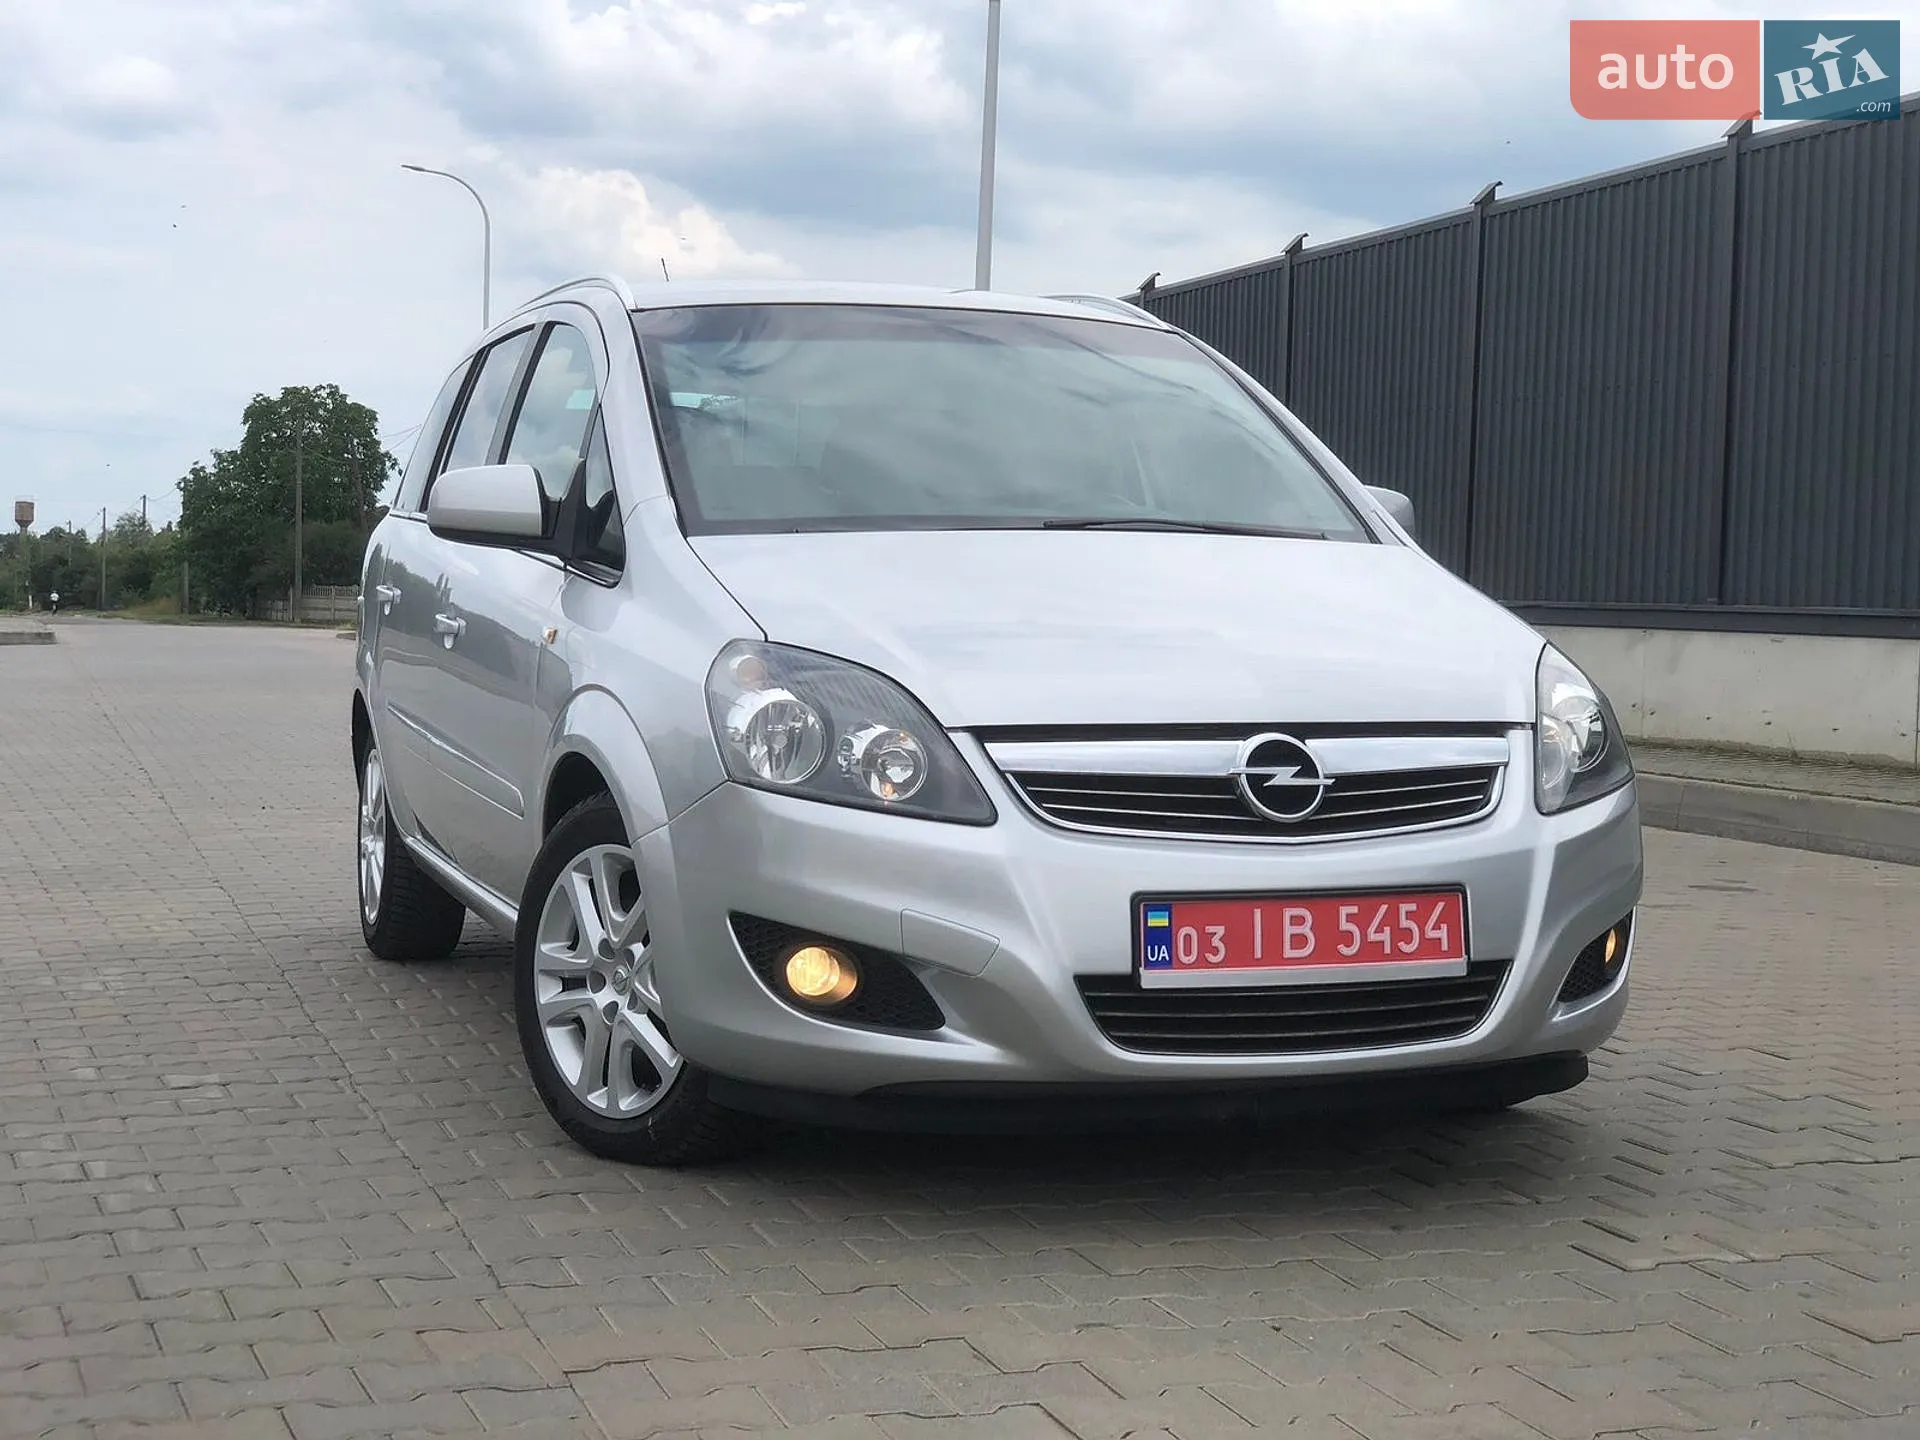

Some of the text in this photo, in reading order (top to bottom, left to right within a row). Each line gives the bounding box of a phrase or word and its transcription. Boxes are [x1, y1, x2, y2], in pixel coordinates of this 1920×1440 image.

[1147, 944, 1170, 962] UA
[1176, 925, 1227, 965] 03
[1336, 901, 1448, 957] 5454
